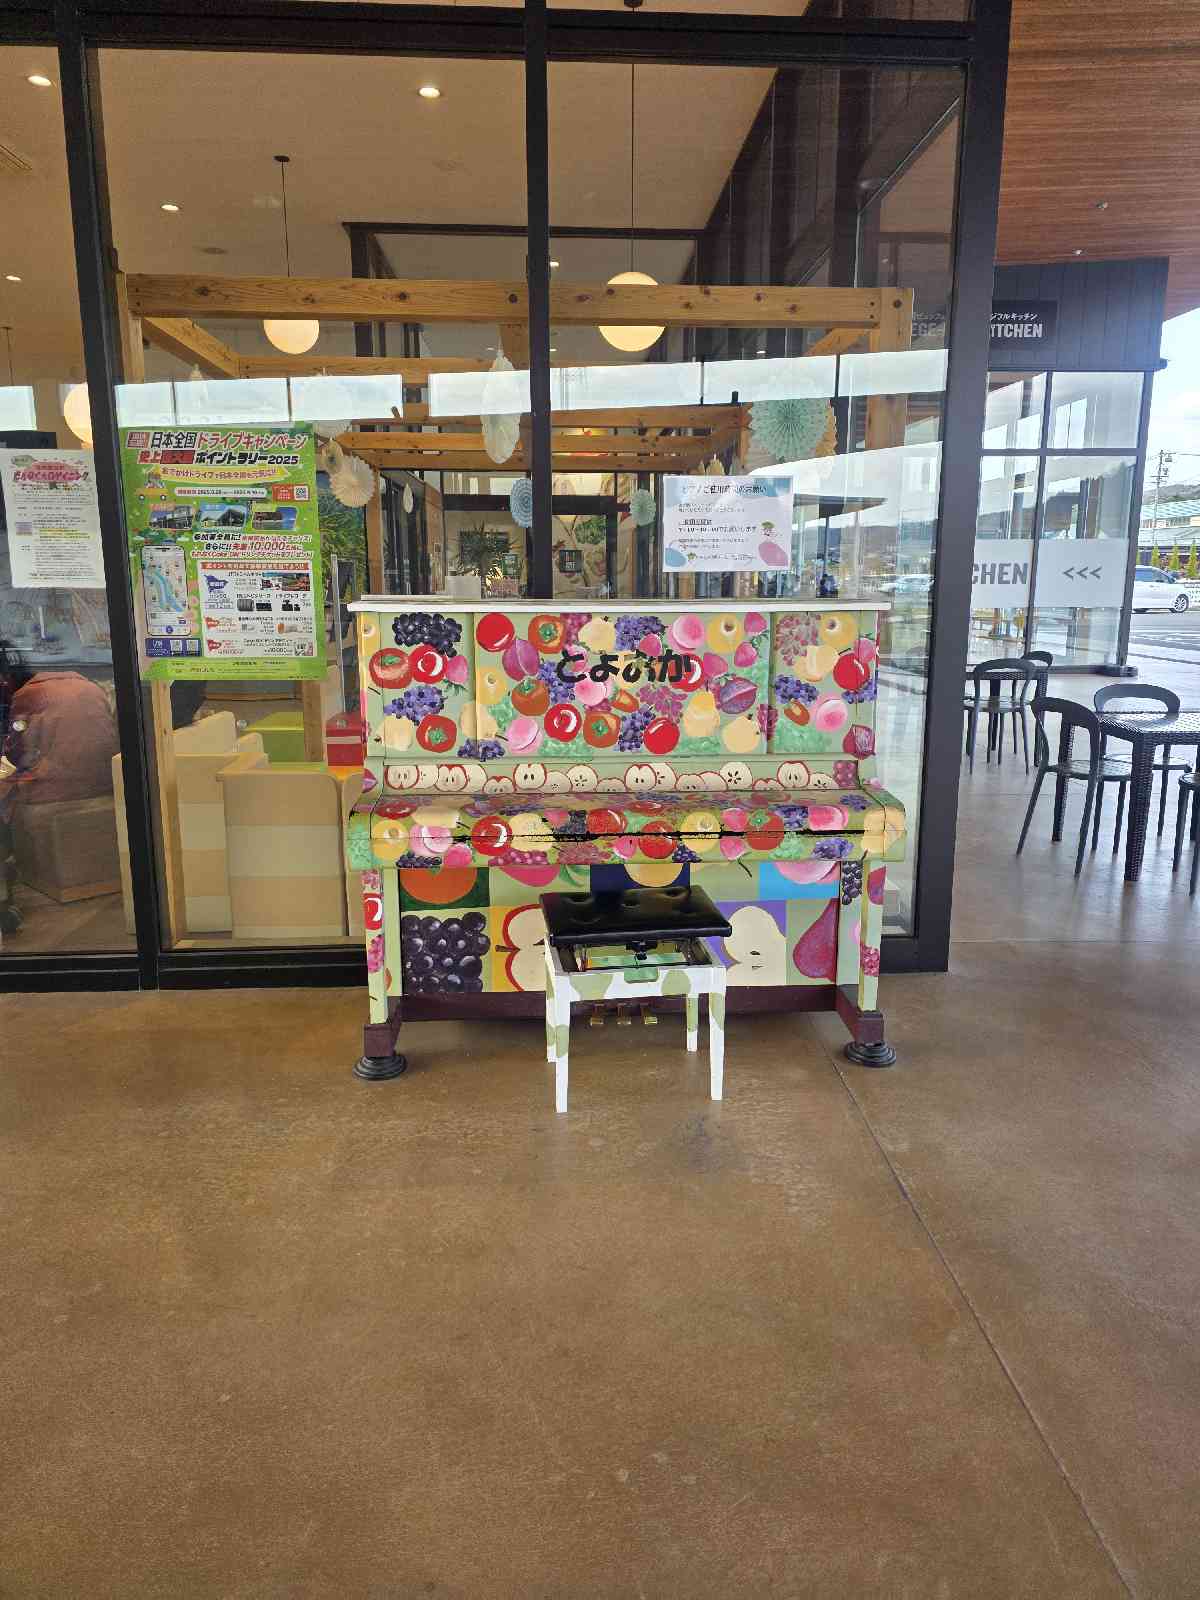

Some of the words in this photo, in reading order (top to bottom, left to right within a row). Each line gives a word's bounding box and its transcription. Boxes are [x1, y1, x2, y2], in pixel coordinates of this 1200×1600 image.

[151, 432, 306, 449] 日本全国ドライブキャンペーン
[556, 649, 692, 683] とよおか
